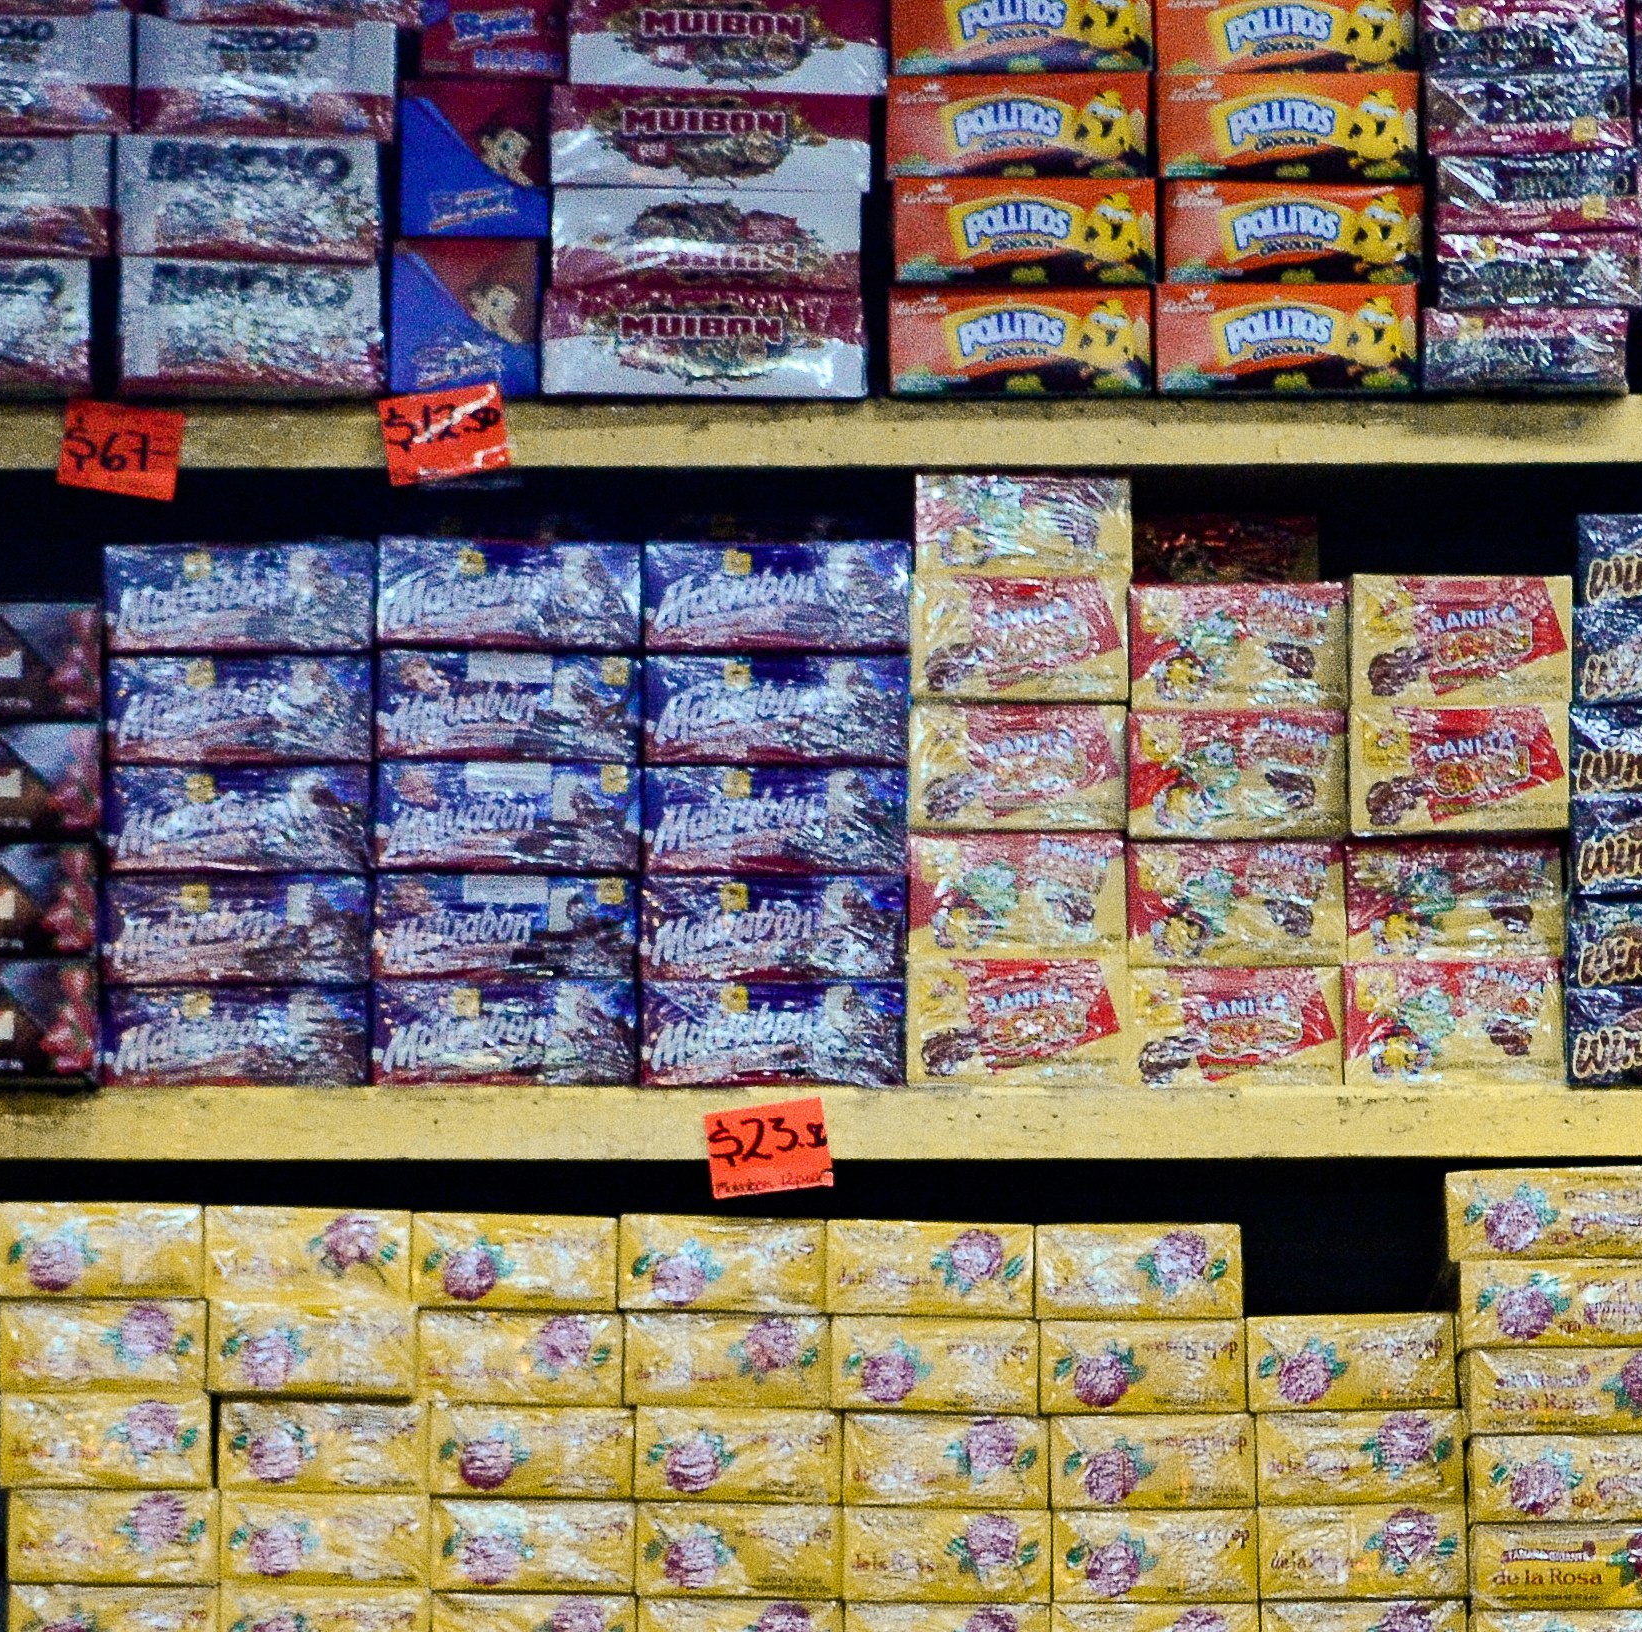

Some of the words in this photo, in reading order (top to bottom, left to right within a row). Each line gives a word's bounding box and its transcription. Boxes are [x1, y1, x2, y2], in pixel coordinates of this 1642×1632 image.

[644, 11, 804, 41] MUIBON
[958, 0, 1064, 40] POLLITOS
[1224, 9, 1332, 51] POLLITOS
[624, 109, 786, 138] MUIBON
[953, 95, 1062, 140] POLLITOS
[1226, 99, 1335, 147] POLLITOS
[961, 200, 1071, 246] POLLITOS
[1232, 205, 1339, 249] POLLITOS
[622, 314, 780, 341] MUIBON
[957, 309, 1065, 356] POLLITOS
[1224, 311, 1332, 356] POLLITOS
[1494, 1570, 1521, 1586] de
[1526, 1569, 1545, 1586] la
[1551, 1569, 1602, 1586] Rosa
